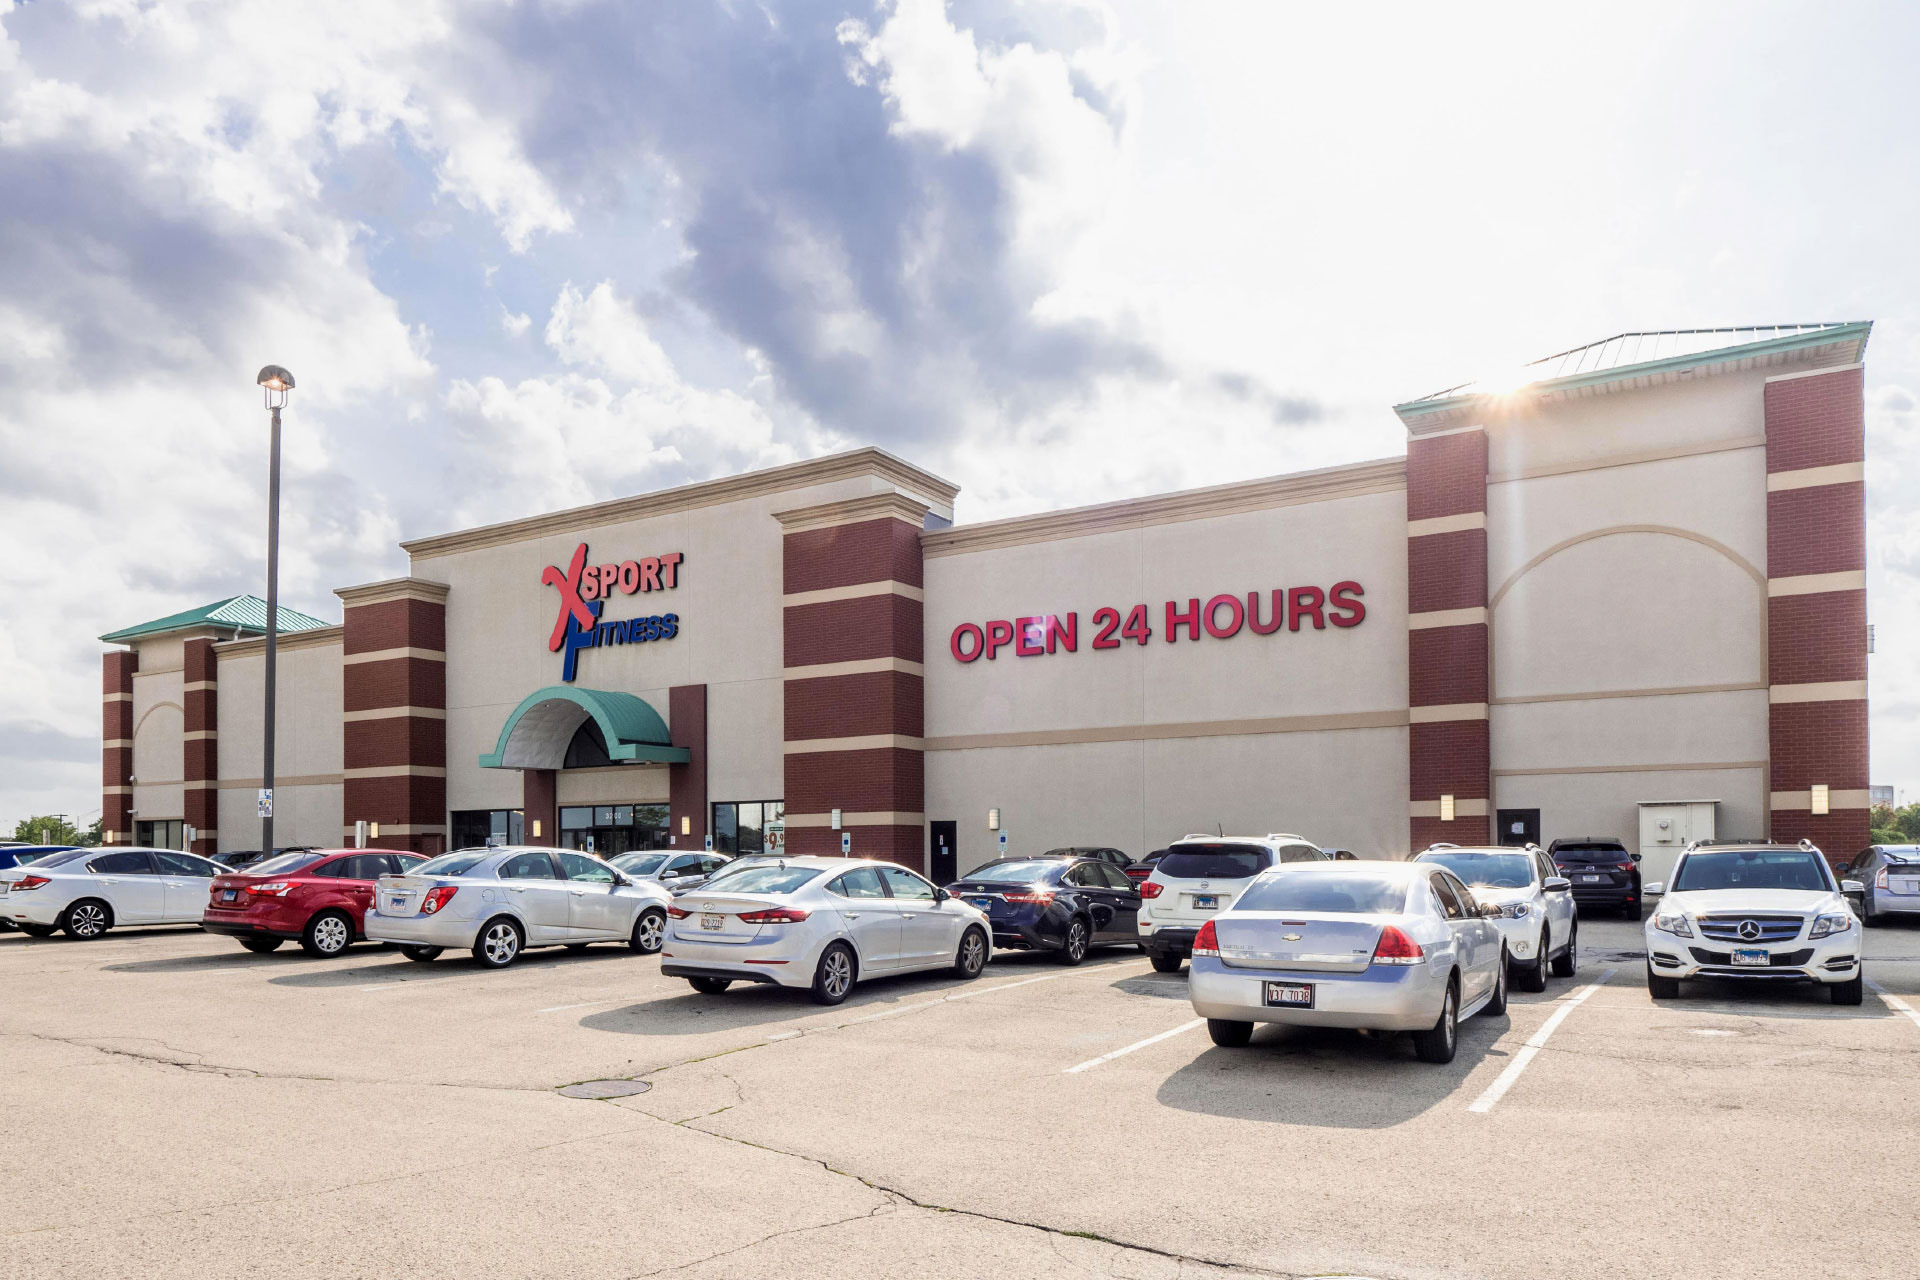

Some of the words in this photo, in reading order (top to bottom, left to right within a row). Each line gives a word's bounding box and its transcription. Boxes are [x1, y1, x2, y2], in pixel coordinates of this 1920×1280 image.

[950, 612, 1078, 662] OPEN
[1092, 604, 1151, 650] 24
[1165, 580, 1366, 643] HOURS
[1269, 990, 1284, 1001] V37
[1289, 990, 1309, 1003] 7038
